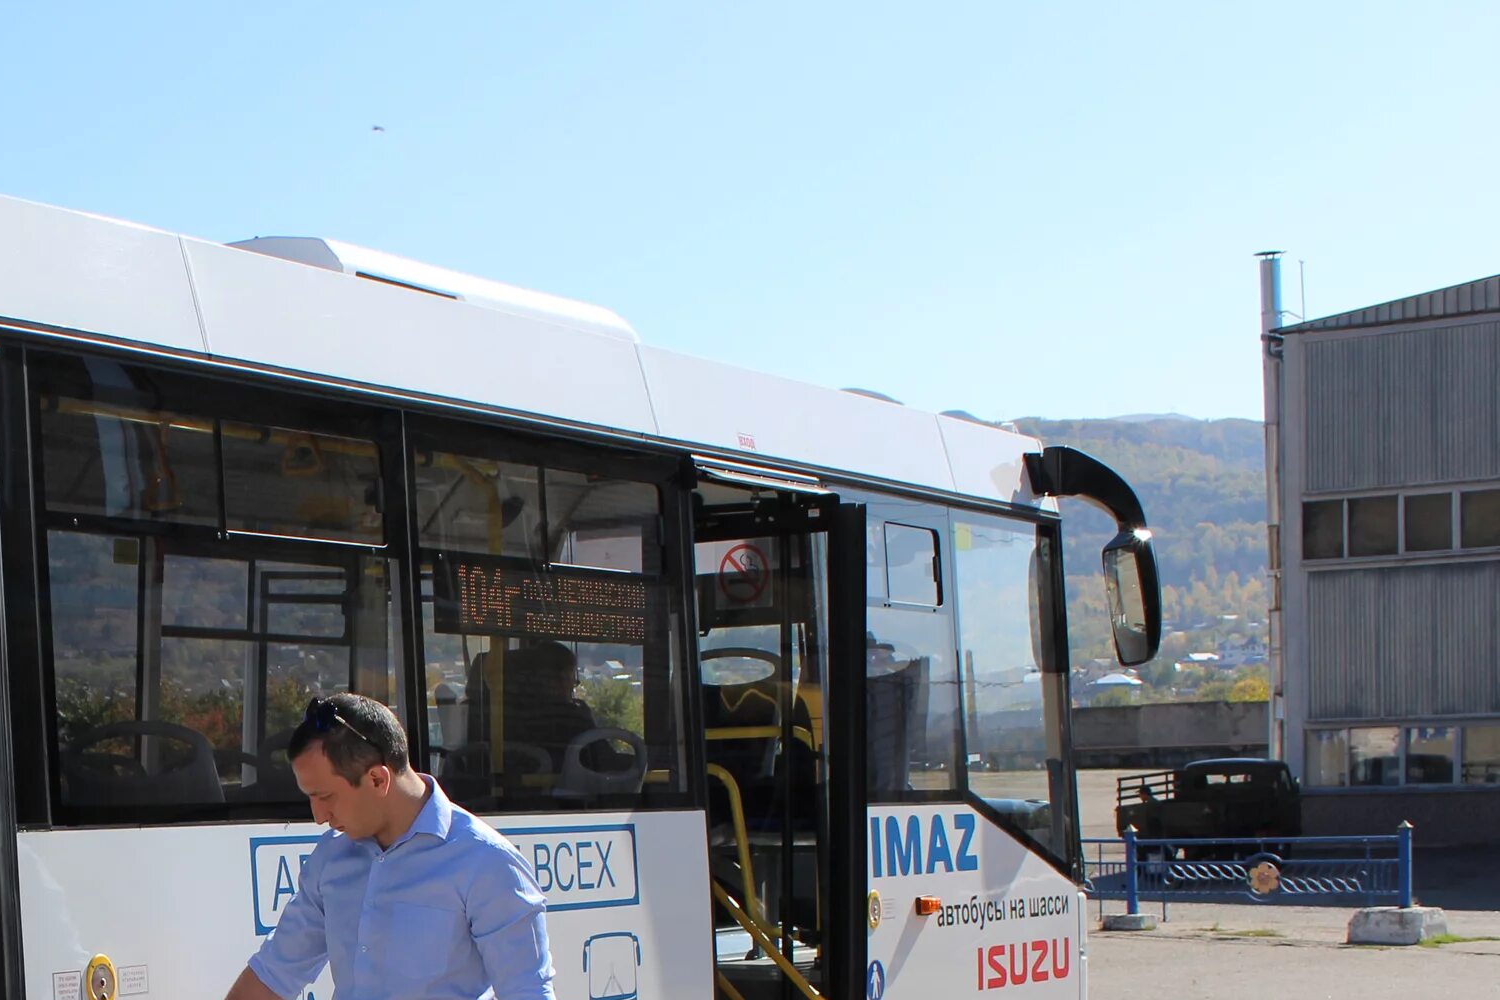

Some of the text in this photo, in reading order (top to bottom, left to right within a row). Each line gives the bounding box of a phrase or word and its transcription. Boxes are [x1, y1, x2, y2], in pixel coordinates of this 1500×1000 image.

[534, 840, 616, 893] ВСЕХ
[870, 813, 979, 878] IMAZ
[937, 895, 1069, 930] автобусы на шасси
[977, 936, 1070, 991] ISUZU
